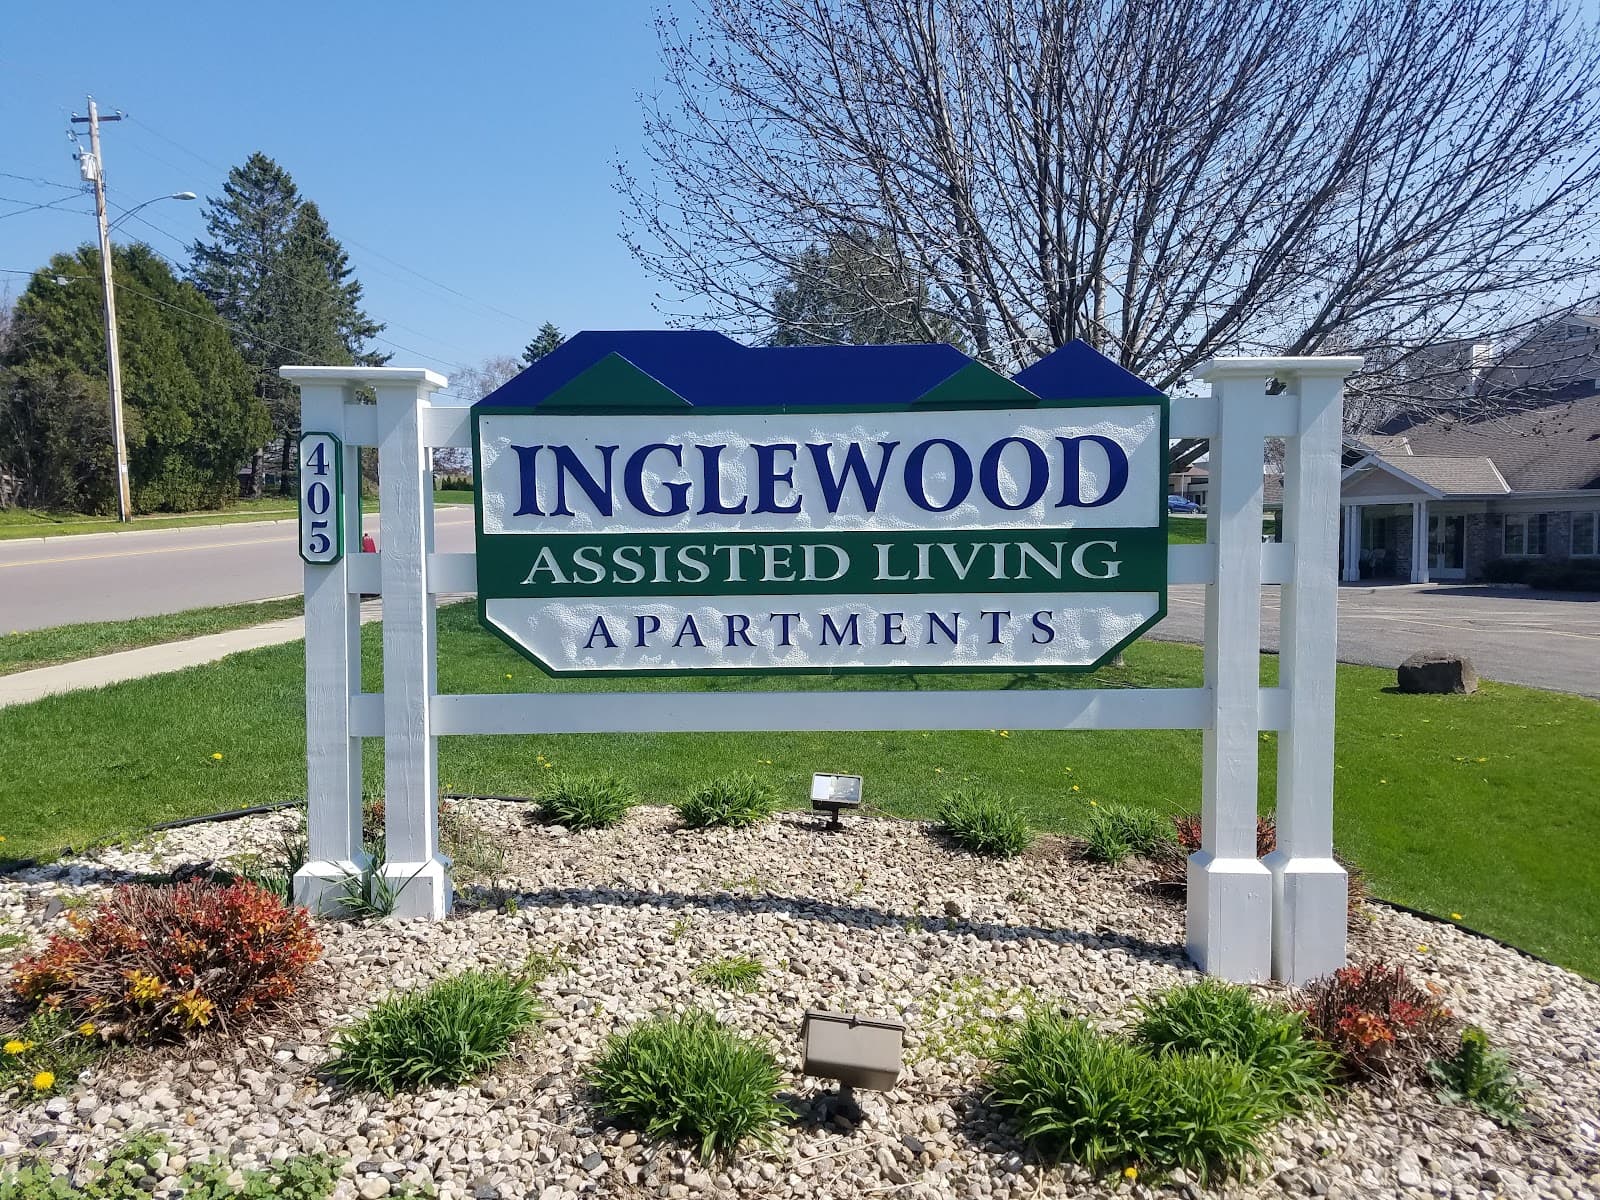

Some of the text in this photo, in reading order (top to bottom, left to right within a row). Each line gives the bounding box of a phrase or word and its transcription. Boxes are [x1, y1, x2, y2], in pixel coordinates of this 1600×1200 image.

[306, 442, 331, 554] 405
[510, 434, 1130, 518] INGLEWOOD
[519, 539, 1122, 586] ASSISTED LIVING
[582, 609, 1056, 650] APARTMENTS
